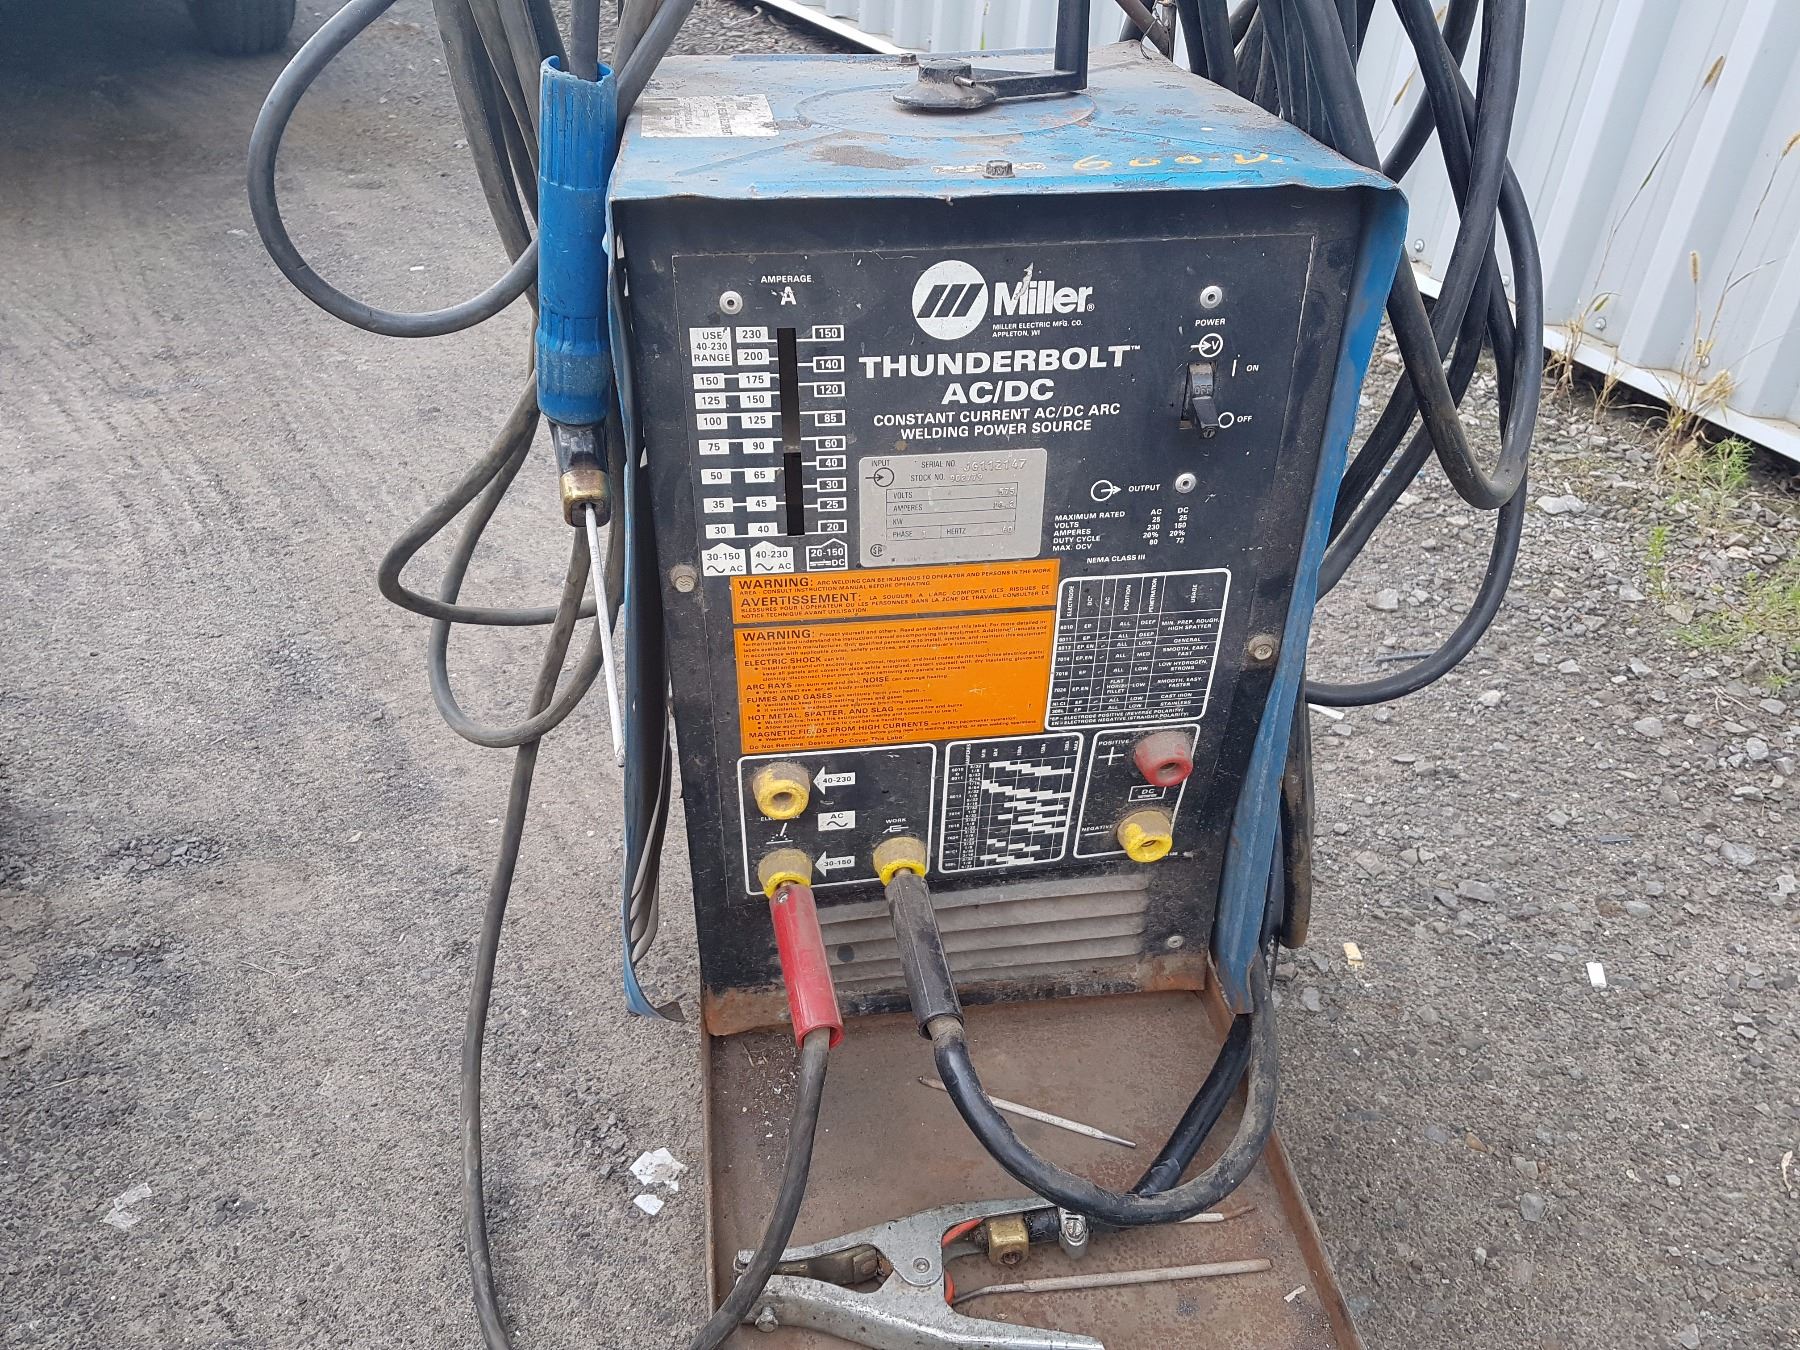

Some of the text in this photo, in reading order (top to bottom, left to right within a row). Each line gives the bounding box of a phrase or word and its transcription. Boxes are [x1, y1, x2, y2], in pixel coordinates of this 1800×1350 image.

[760, 275, 812, 283] AMPERAGE
[780, 286, 797, 305] A
[993, 323, 1017, 331] MILLER
[1019, 321, 1050, 330] ELECTRIC
[1052, 320, 1070, 328] MFG.
[1195, 318, 1226, 327] POWER
[702, 329, 838, 340] USE 230 150
[992, 330, 1030, 338] APPLETON,
[696, 342, 728, 350] 40-230
[694, 352, 839, 369] RANGE 200 140
[700, 375, 839, 394] 150 175 120
[941, 378, 1055, 404] AC/DC
[702, 395, 765, 405] 125 150
[874, 402, 1122, 427] CONSTANT CURRENT AC/DC ARC
[703, 414, 837, 426] 100 125 85
[901, 419, 1092, 440] WELDING POWER SOURCE
[708, 439, 838, 451] 75 90 60
[825, 458, 838, 467] 40
[871, 459, 890, 468] INPUT
[921, 461, 944, 470] SERIAL
[710, 471, 766, 480] 50 65
[910, 474, 932, 482] STOCK
[826, 480, 838, 489] 30
[1128, 484, 1161, 492] OUTPUT
[893, 488, 1016, 500] VOLTS 575
[712, 500, 839, 509] 35 45 25
[893, 504, 923, 512] AMPERES
[1055, 513, 1097, 521] MAXIMUM
[714, 523, 839, 535] 30 40 20
[1054, 528, 1092, 536] AMPERES
[892, 530, 913, 538] PHASE
[706, 548, 844, 561] 30-150 40-230 20-150
[729, 558, 845, 572] AC AC DC
[739, 577, 813, 590] WARNING:
[740, 592, 861, 608] AVERTISSEMENT:
[742, 629, 816, 642] WARNING:
[744, 656, 822, 666] ELECTRIC SHOCK
[862, 676, 890, 684] NOISE
[748, 730, 796, 738] MAGNETIC
[882, 720, 929, 729] CURRENTS
[822, 776, 852, 784] 40-230
[1081, 824, 1113, 832] NEGATIVE
[824, 859, 852, 867] 30-150
